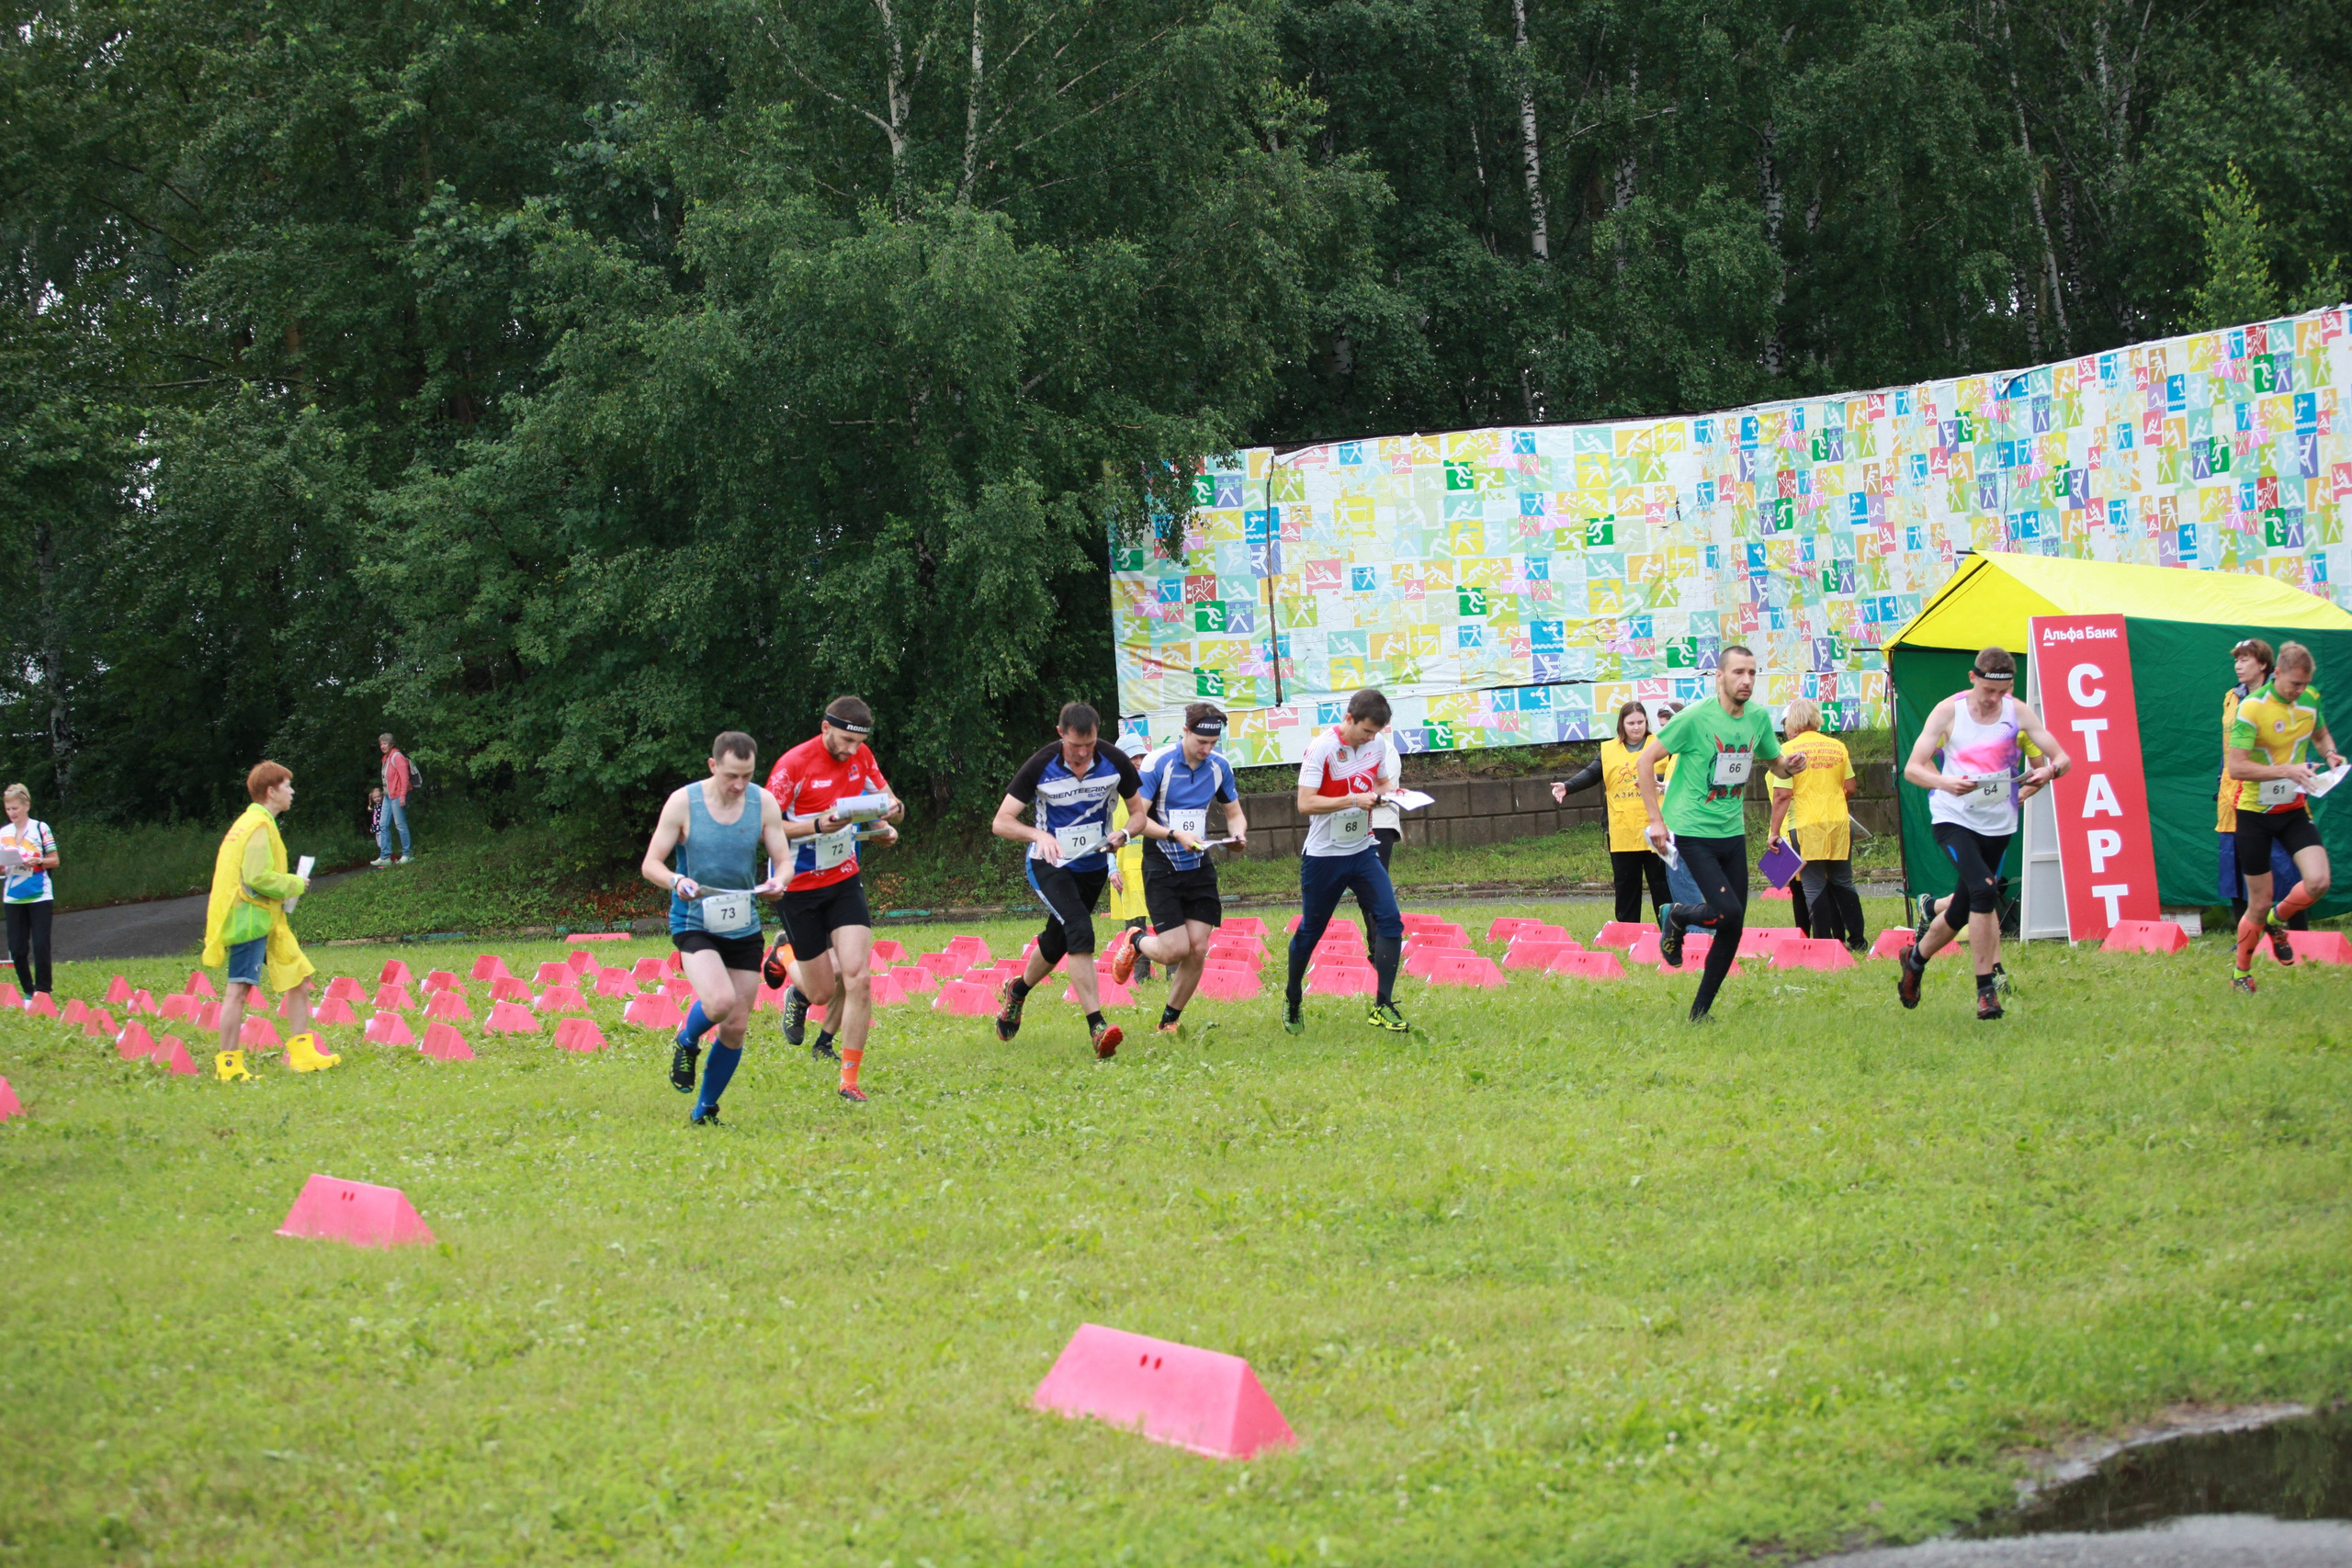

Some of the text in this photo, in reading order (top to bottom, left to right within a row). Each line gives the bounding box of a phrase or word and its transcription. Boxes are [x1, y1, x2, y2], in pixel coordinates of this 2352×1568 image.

[2042, 626, 2118, 643] Альфа Банк
[1728, 762, 1742, 773] 66
[1984, 784, 1998, 796] 64
[2272, 784, 2286, 795] 61
[2067, 663, 2129, 929] СТАРТ
[1182, 820, 1195, 831] 69
[1345, 821, 1358, 832] 68
[1071, 836, 1087, 847] 70
[831, 843, 844, 856] 72
[721, 907, 736, 920] 73
